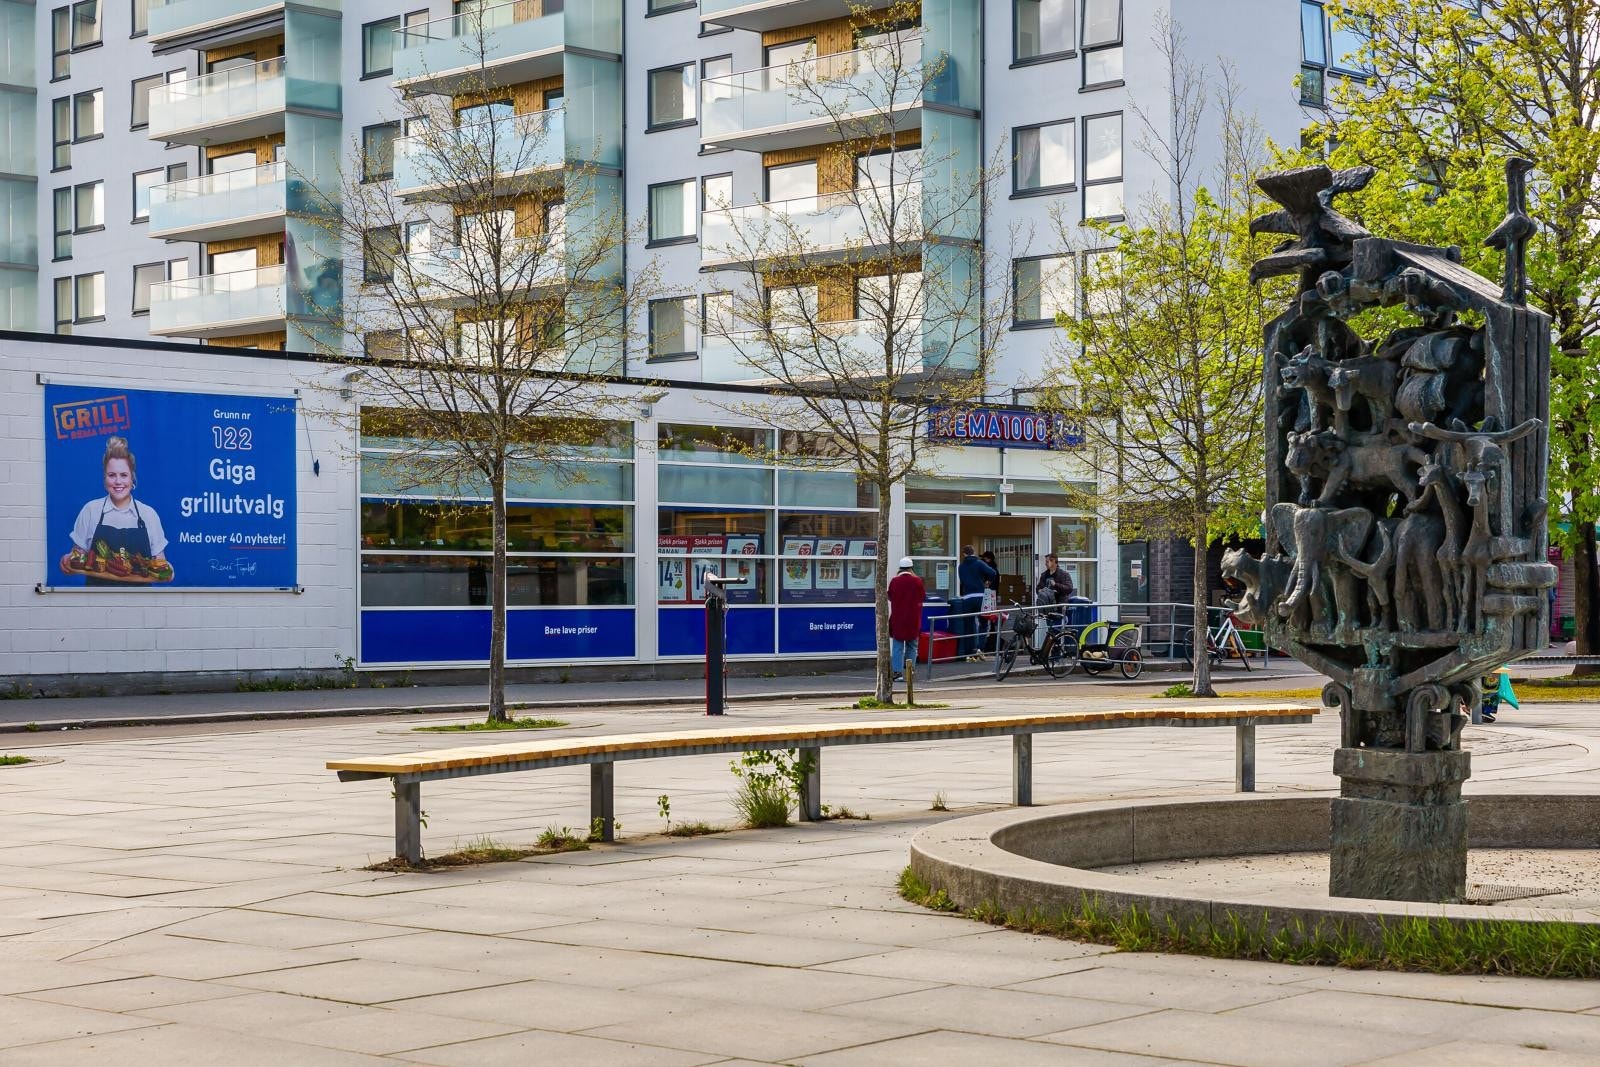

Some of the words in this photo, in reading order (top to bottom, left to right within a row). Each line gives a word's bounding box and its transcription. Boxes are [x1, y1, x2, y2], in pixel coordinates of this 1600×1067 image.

[61, 403, 125, 430] GRILL
[213, 409, 240, 419] Grunn
[241, 412, 251, 420] nr
[212, 426, 252, 450] 122
[209, 458, 256, 485] Giga
[180, 492, 285, 519] grillutvalg
[180, 532, 203, 543] Med
[205, 534, 227, 544] over
[229, 533, 243, 544] 40
[245, 533, 286, 546] nyheter!
[658, 560, 674, 587] 14
[674, 561, 683, 574] 90
[544, 625, 561, 635] Bare
[562, 625, 577, 635] lave
[577, 625, 598, 636] priser
[809, 622, 823, 631] Bare
[824, 621, 836, 630] lave
[836, 621, 854, 631] priser
